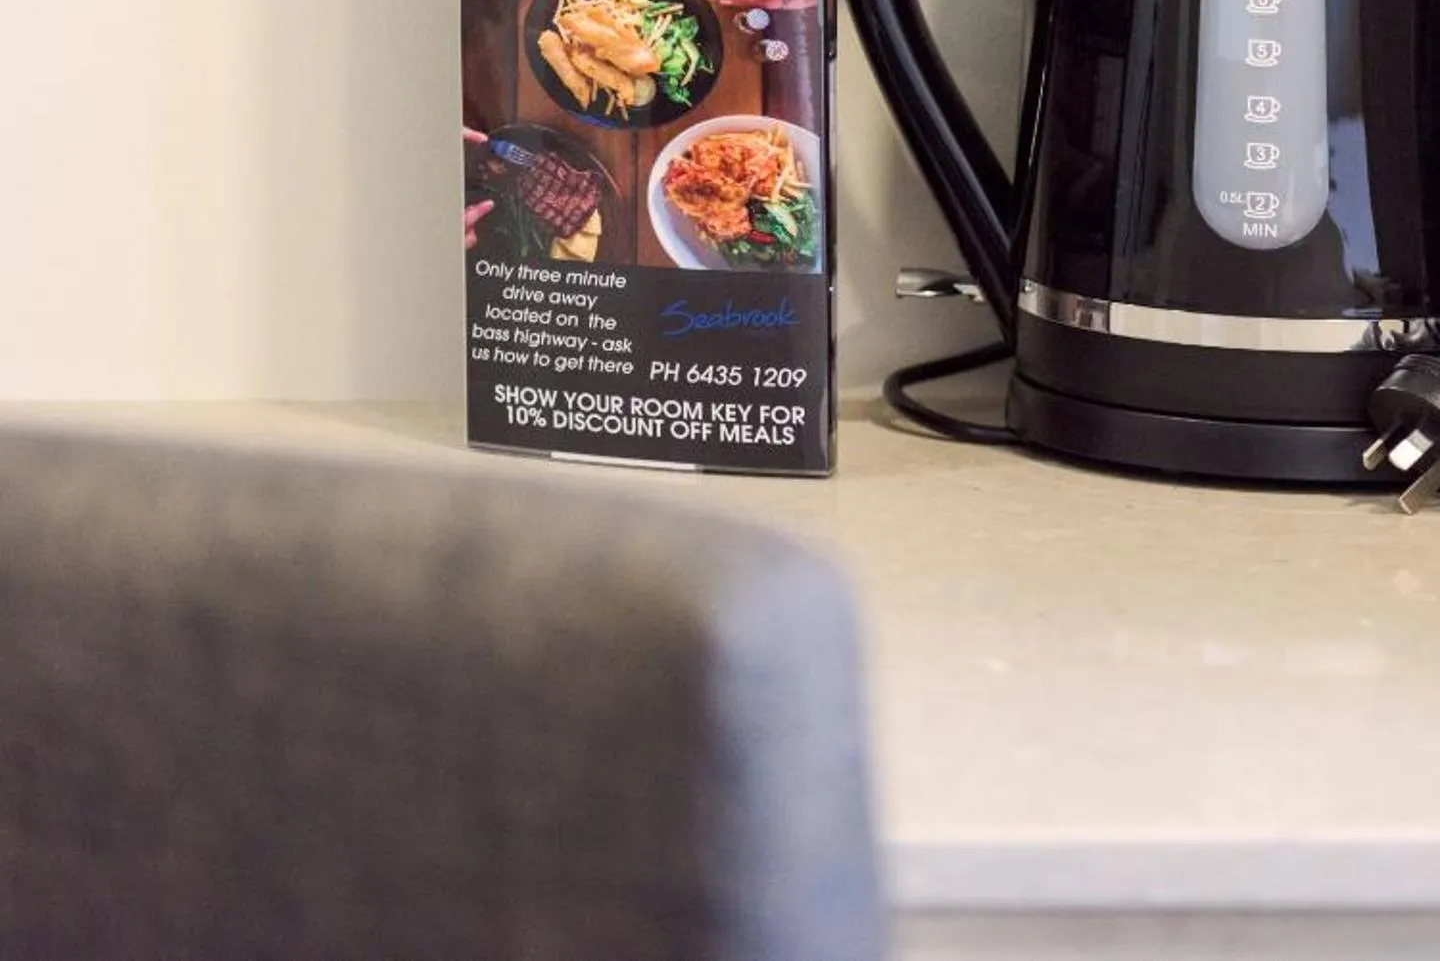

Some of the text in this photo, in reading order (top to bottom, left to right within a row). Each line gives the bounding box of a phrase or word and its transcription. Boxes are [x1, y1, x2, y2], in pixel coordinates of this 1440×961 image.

[1243, 223, 1278, 238] MIN
[475, 260, 627, 289] Only three minute
[503, 285, 598, 311] drive away
[485, 304, 617, 330] located on the
[660, 299, 799, 337] Seabrook
[472, 323, 509, 342] bass
[514, 329, 588, 351] highway
[602, 336, 632, 353] ask
[472, 347, 634, 375] us how to get there
[650, 361, 807, 389] PH 6435 1209
[494, 384, 806, 426] SHOW YOUR ROOM KEY FOR
[506, 406, 795, 446] 10% DISCOUNT OFF MEALS
